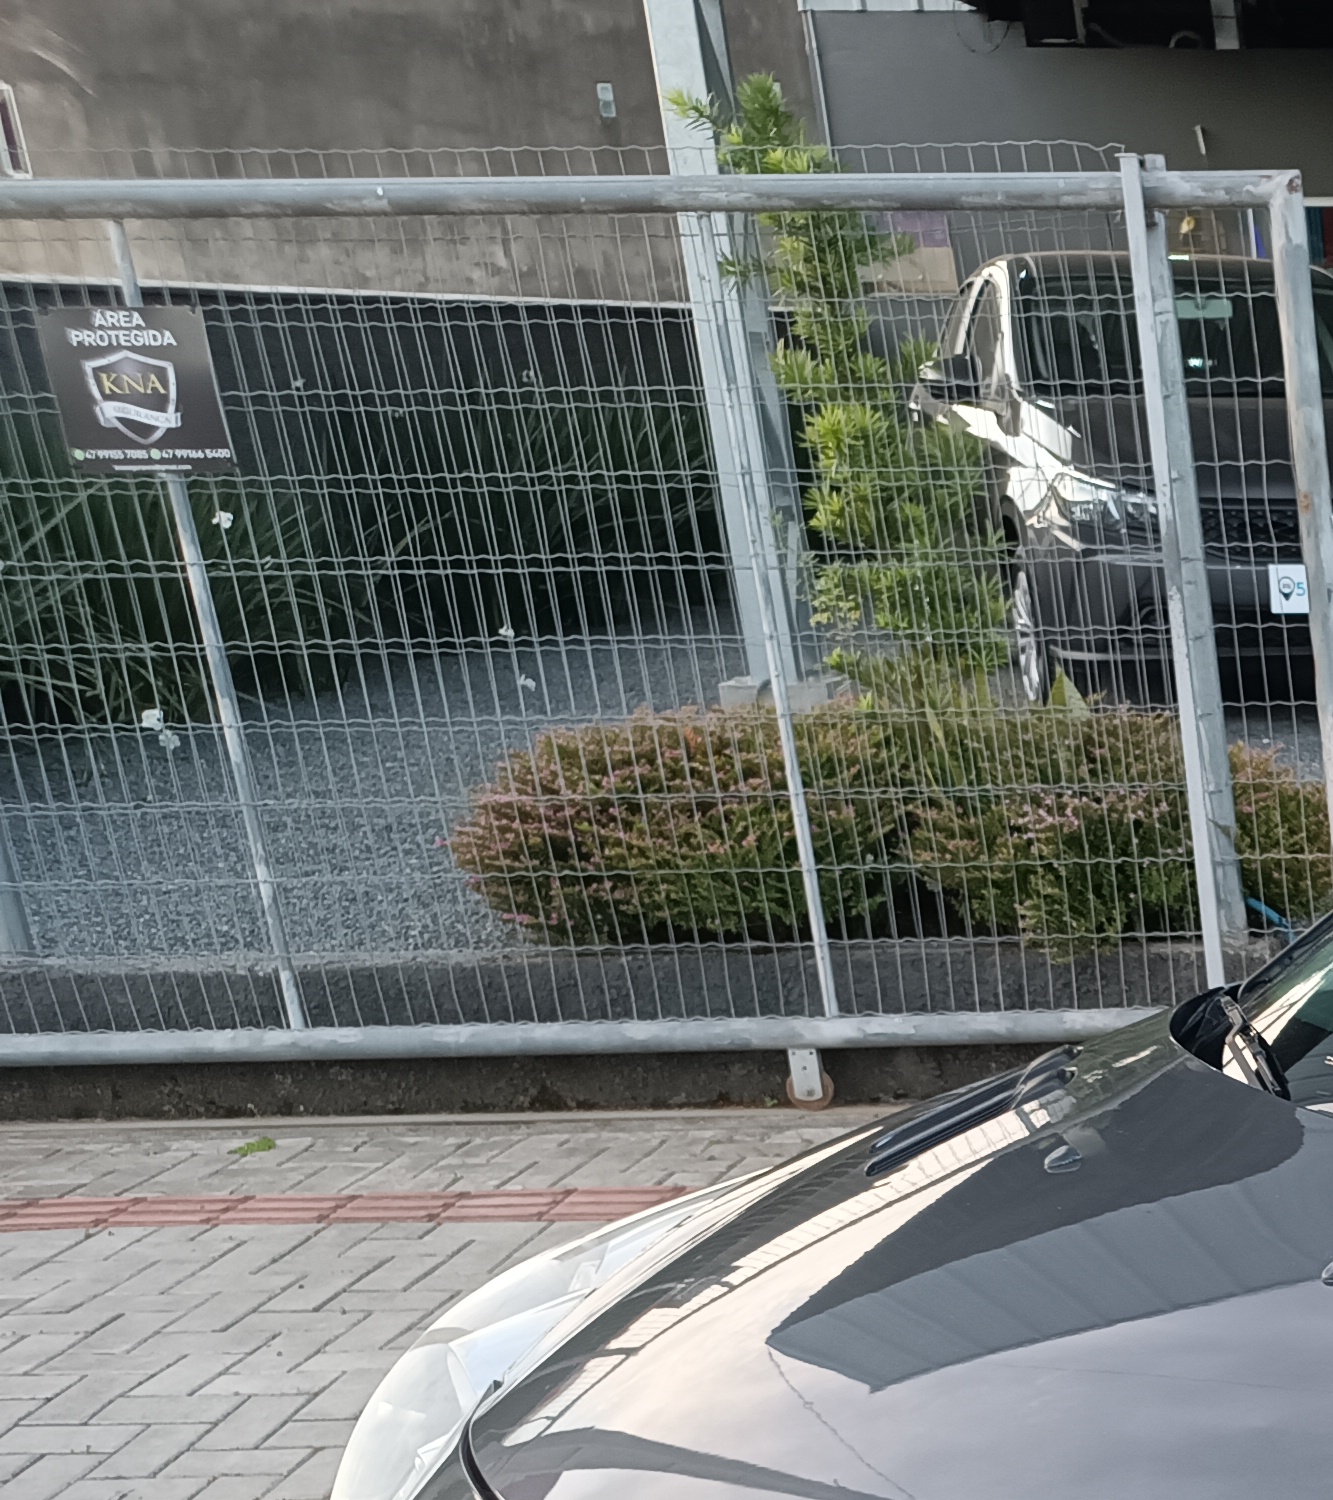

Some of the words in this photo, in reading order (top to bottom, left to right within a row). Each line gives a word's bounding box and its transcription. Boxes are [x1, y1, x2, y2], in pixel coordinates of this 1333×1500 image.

[93, 308, 146, 328] ÁREA
[69, 329, 178, 347] PROTEGIDA
[99, 372, 168, 395] KNA
